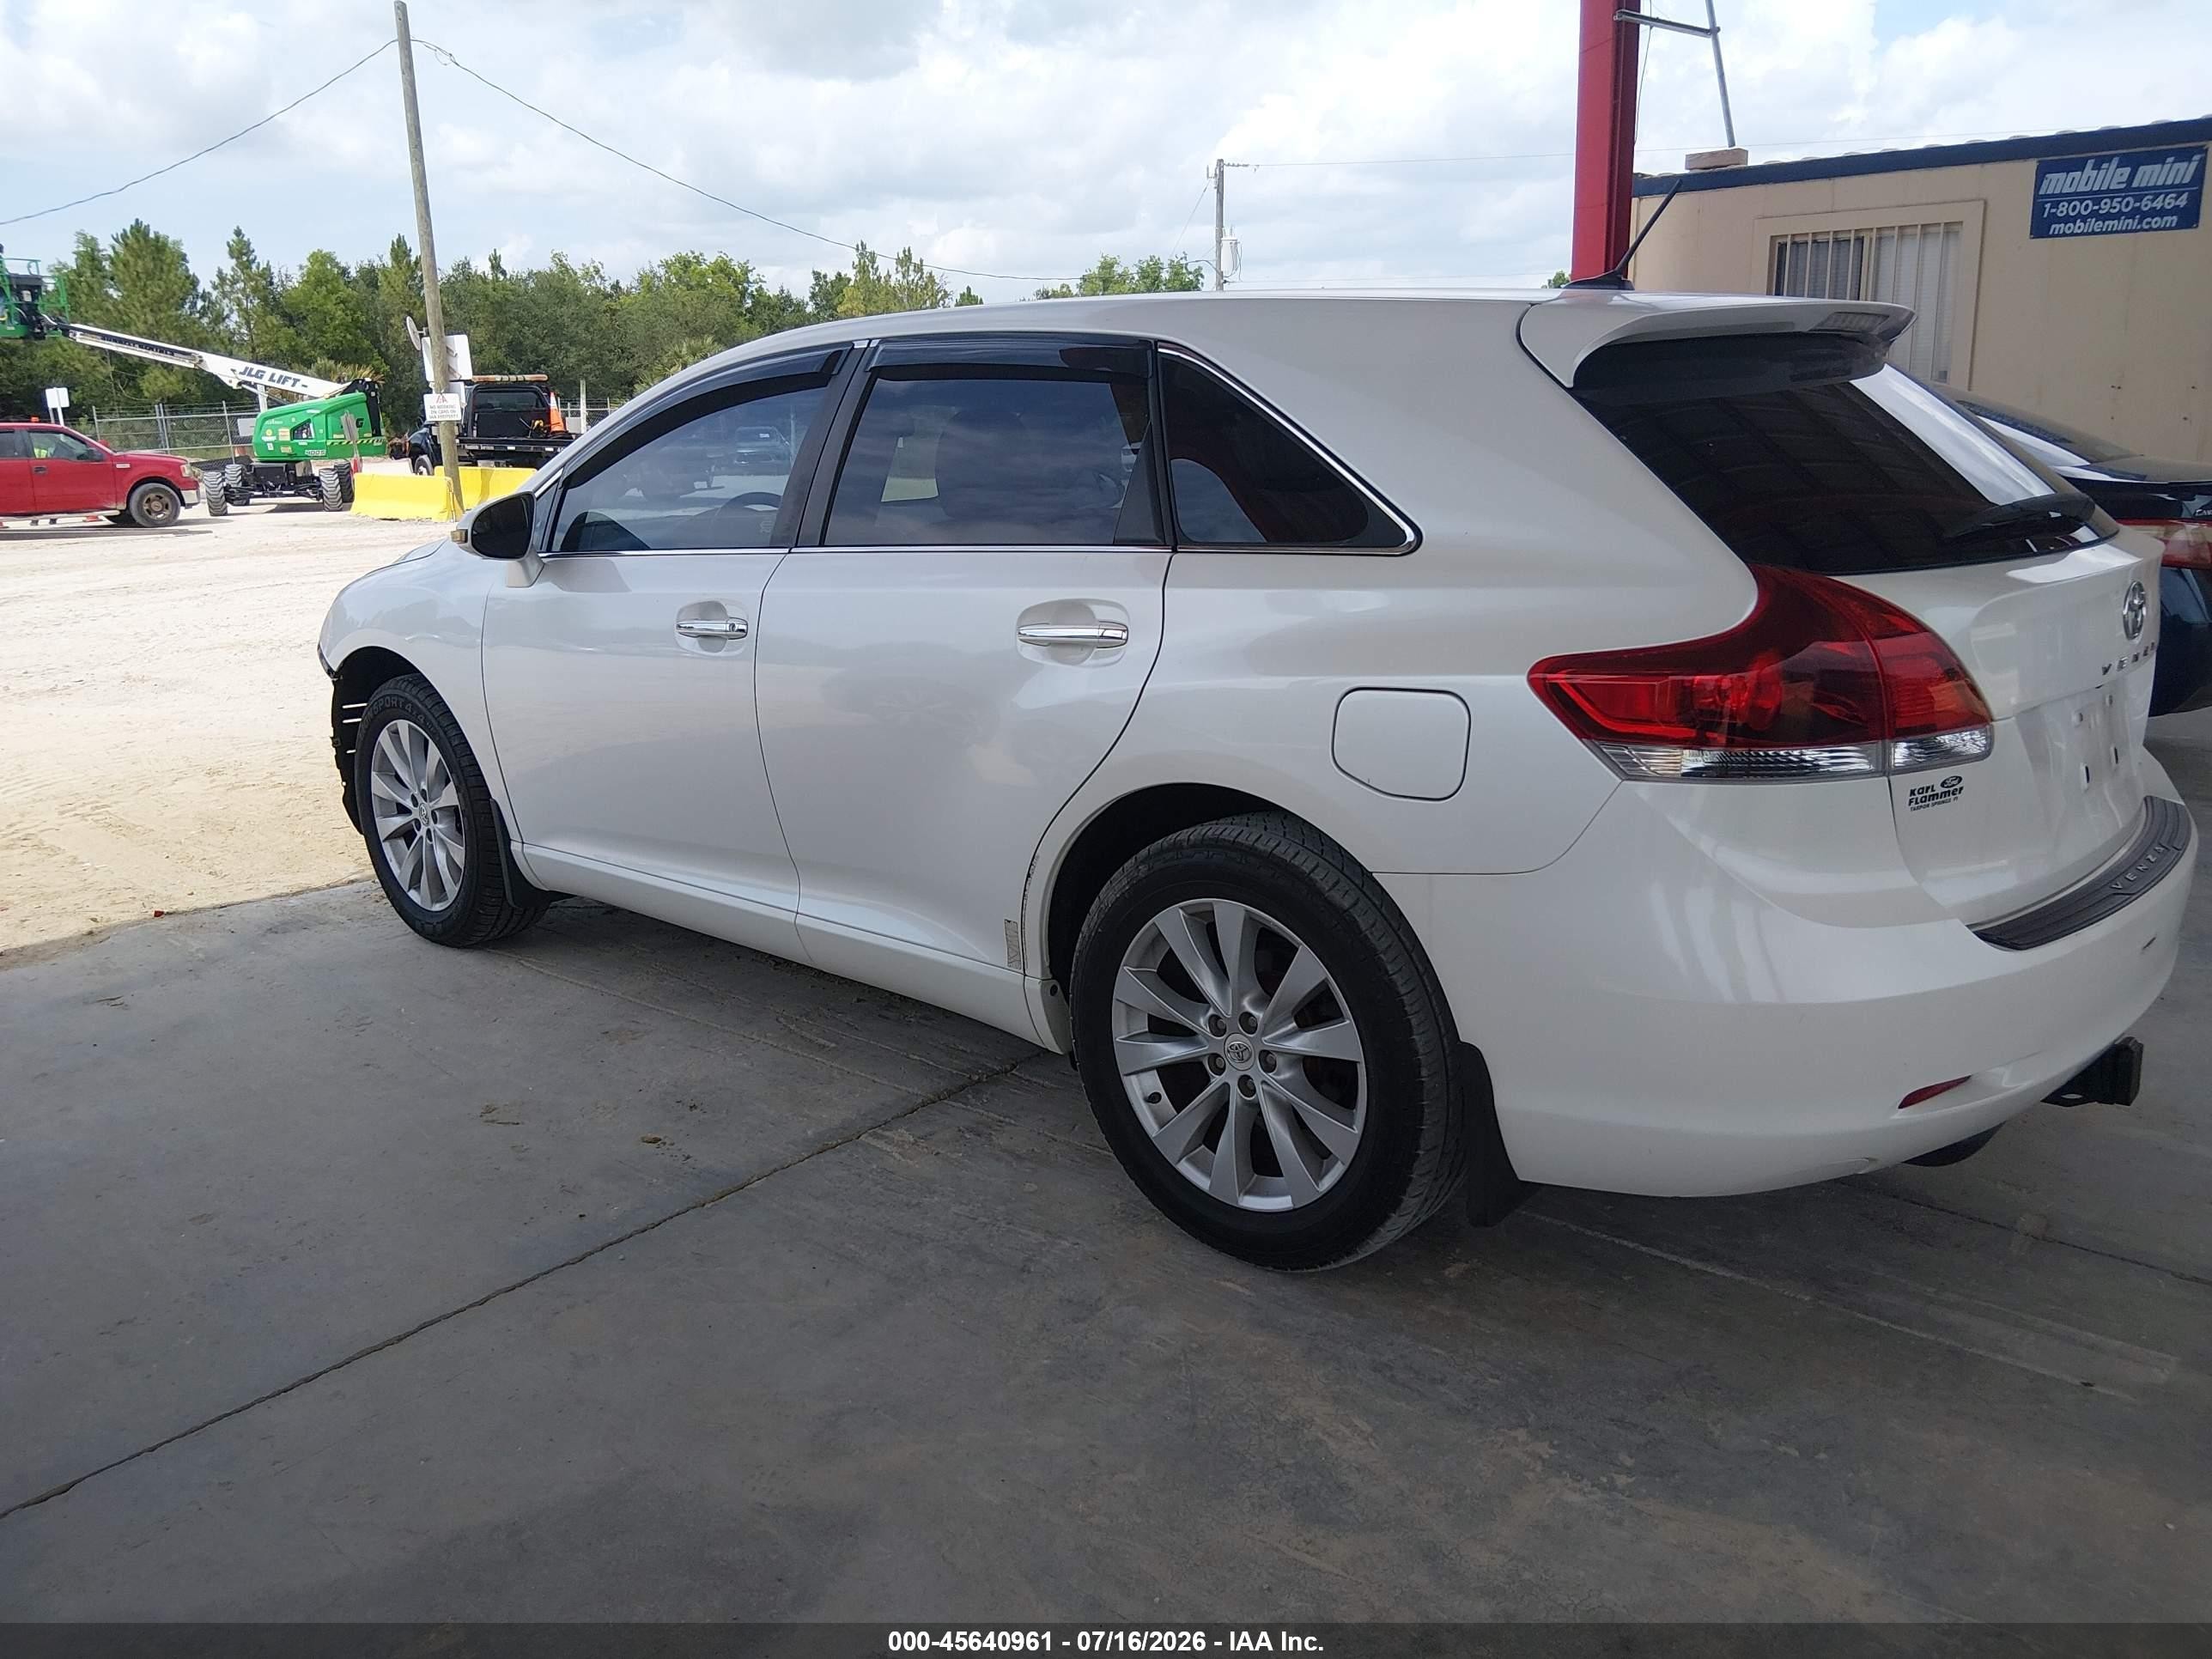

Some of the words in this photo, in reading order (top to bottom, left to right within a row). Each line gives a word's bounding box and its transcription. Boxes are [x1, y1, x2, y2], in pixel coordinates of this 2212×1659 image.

[2039, 157, 2131, 195] mobile
[2131, 154, 2204, 187] mini
[2043, 192, 2188, 217] 1-800-950-6464
[2049, 215, 2178, 234] mobilemini.com
[239, 367, 266, 380] JLG
[268, 373, 301, 387] LIFT
[373, 696, 404, 714] SPORT
[2111, 844, 2166, 890] VENZA
